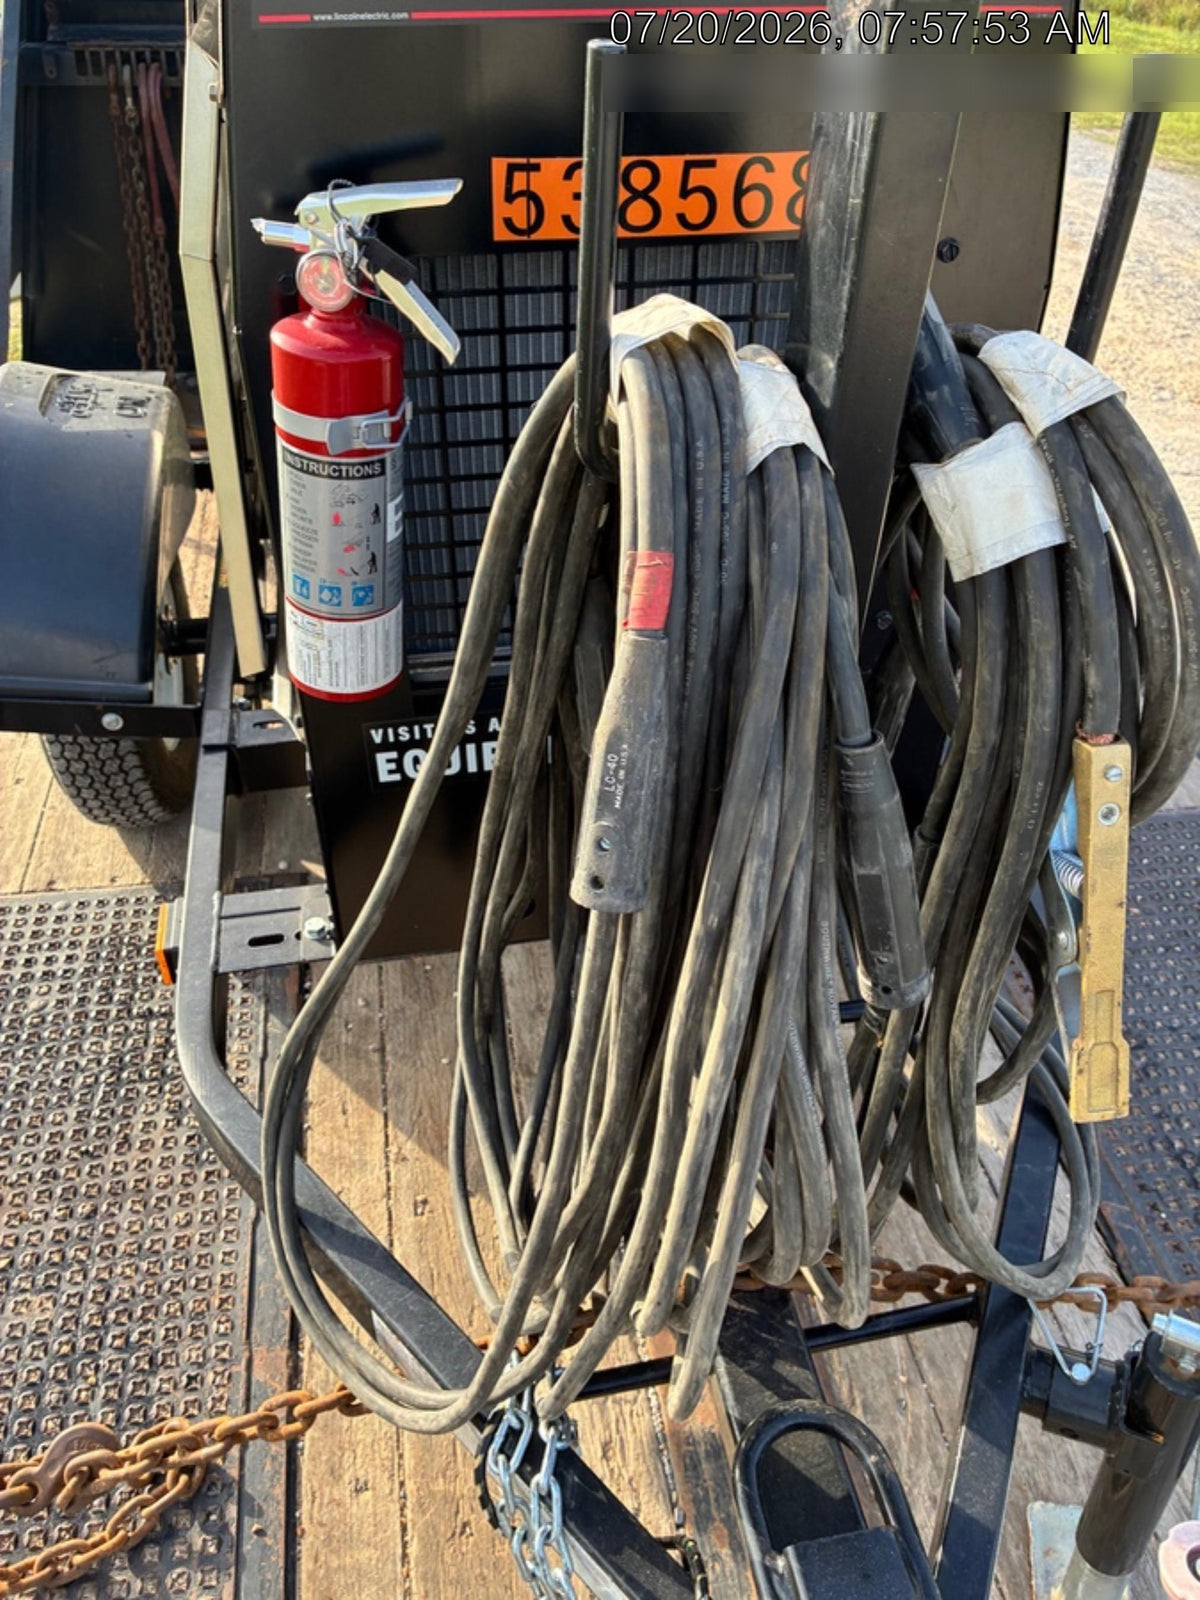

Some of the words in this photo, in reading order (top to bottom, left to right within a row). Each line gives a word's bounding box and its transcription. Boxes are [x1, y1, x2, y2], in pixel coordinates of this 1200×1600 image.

[312, 11, 410, 23] www.lincolnelectric.com
[284, 454, 382, 478] INSTRUCTIONS
[370, 723, 434, 744] VISIT
